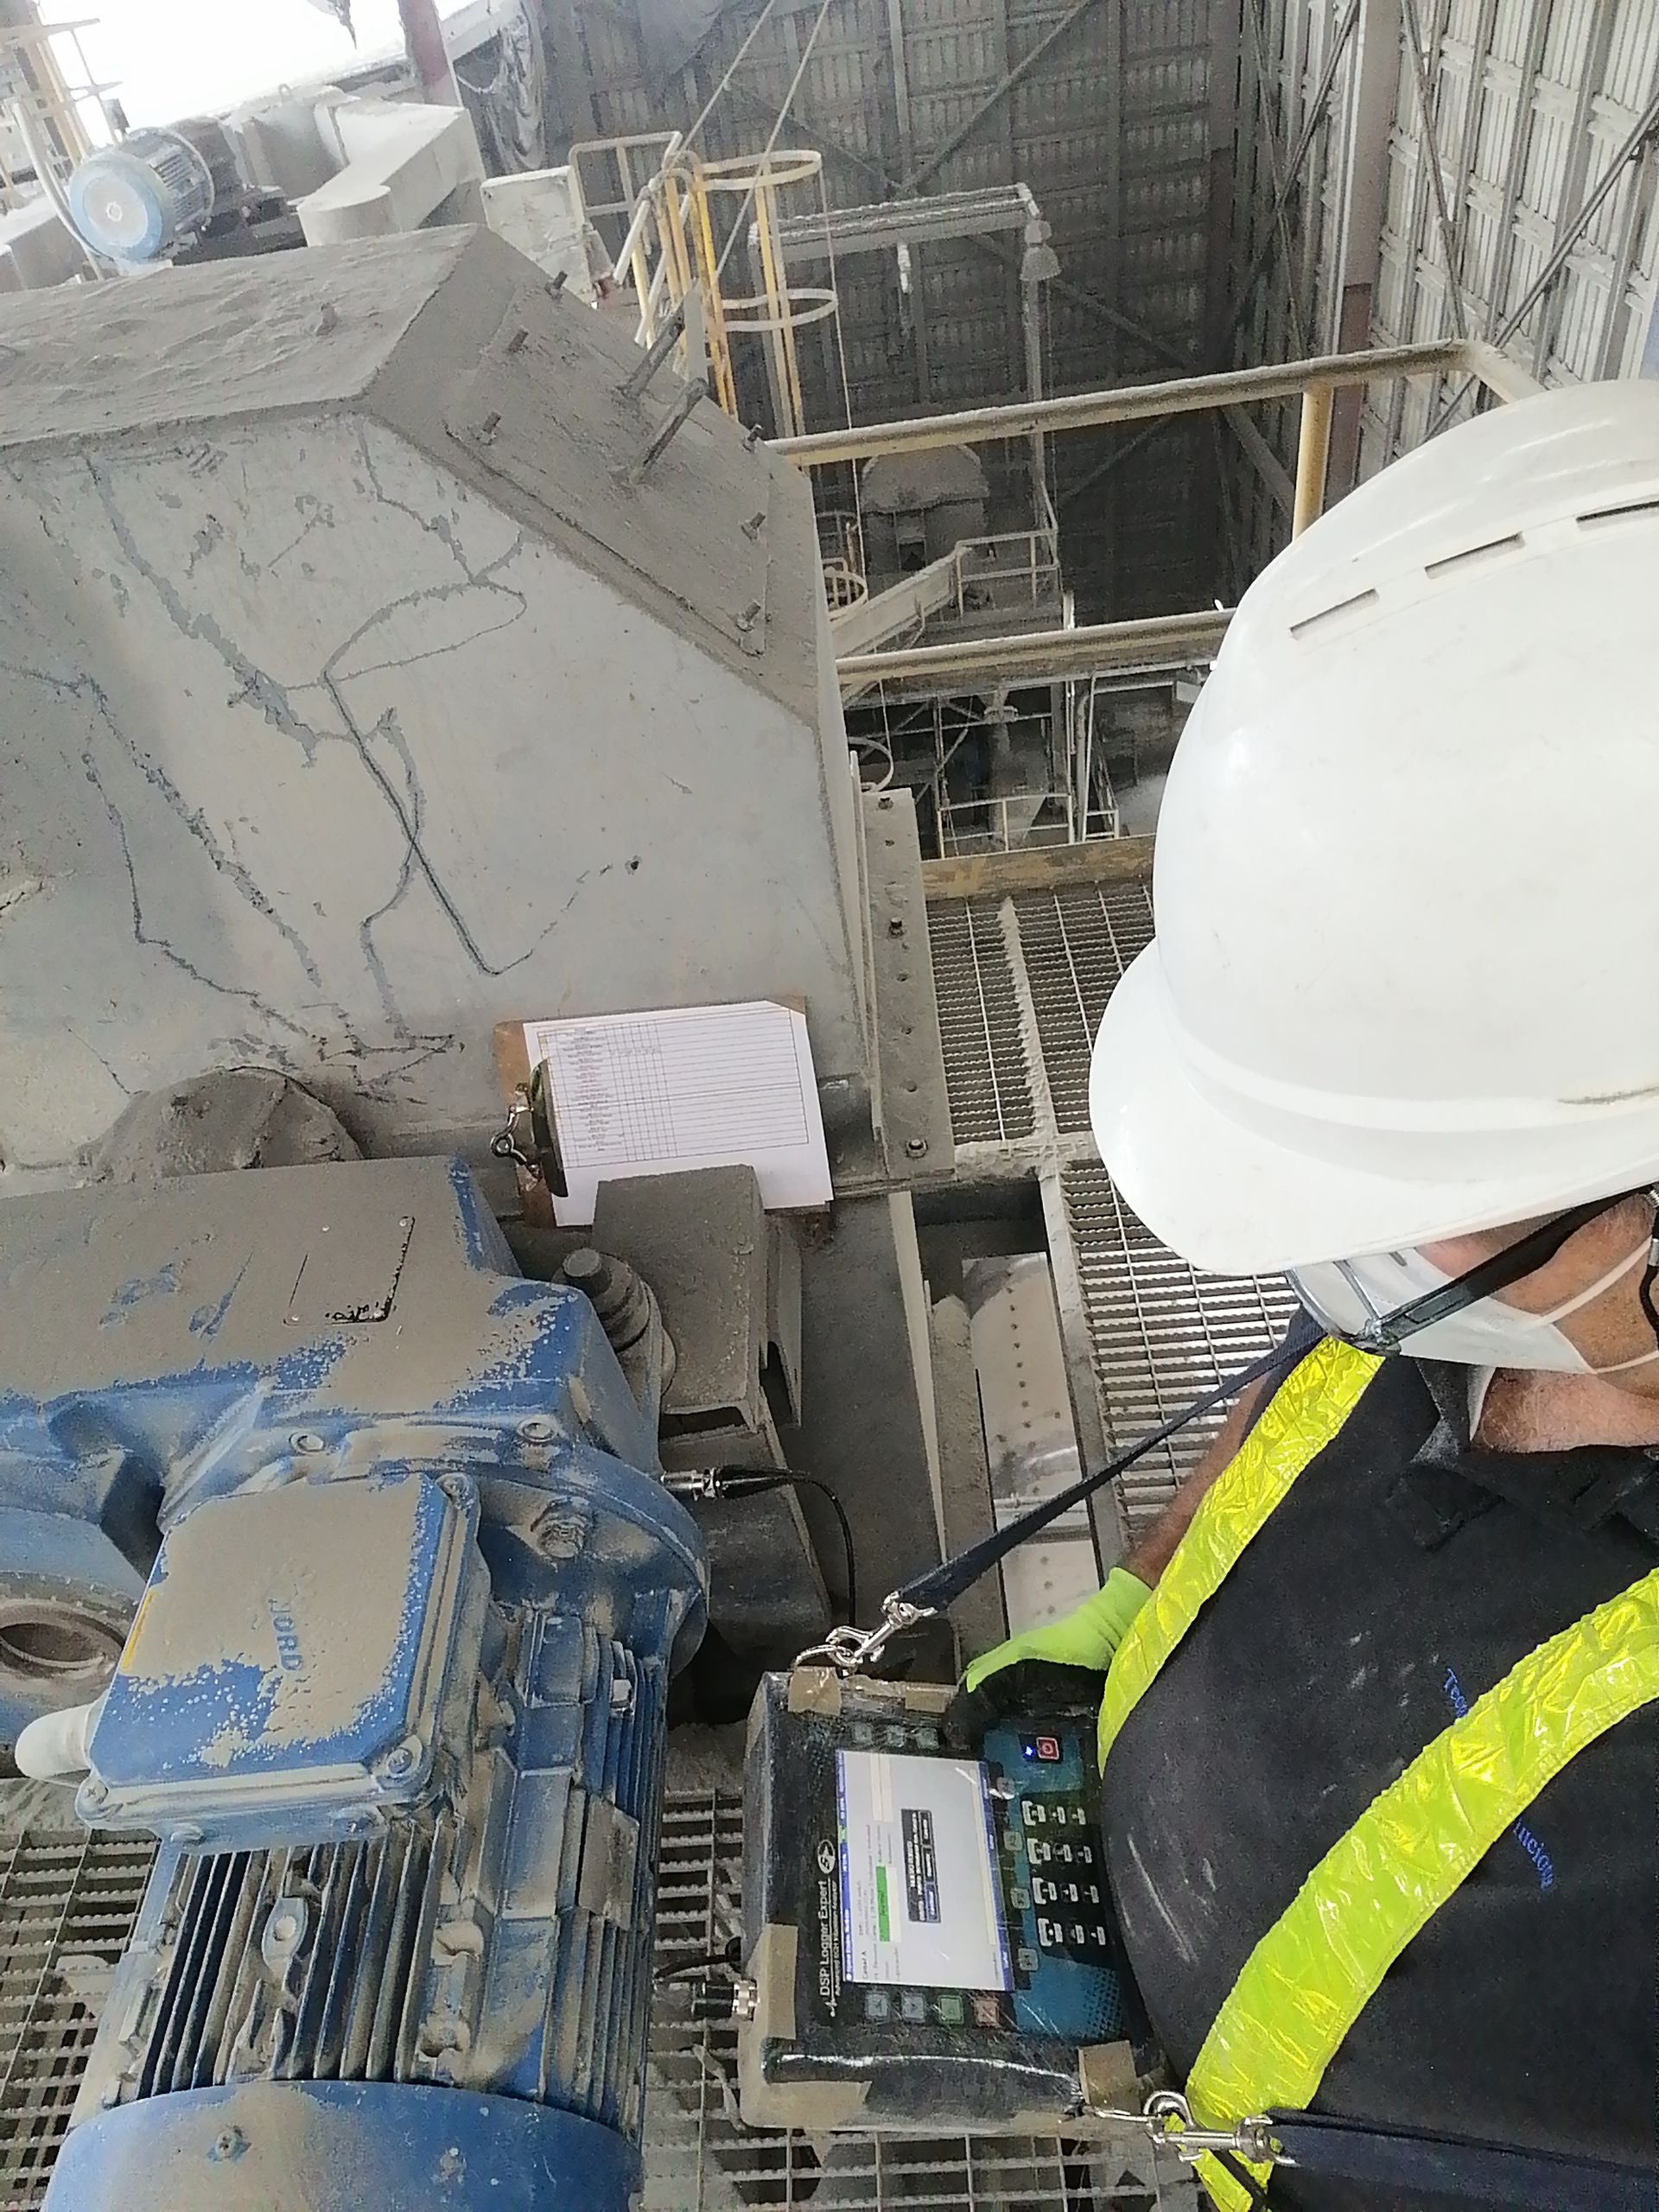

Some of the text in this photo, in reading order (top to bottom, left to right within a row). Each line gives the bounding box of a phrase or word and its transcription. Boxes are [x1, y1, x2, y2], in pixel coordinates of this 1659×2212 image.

[817, 1880, 832, 1997] DSP Logger Expert
